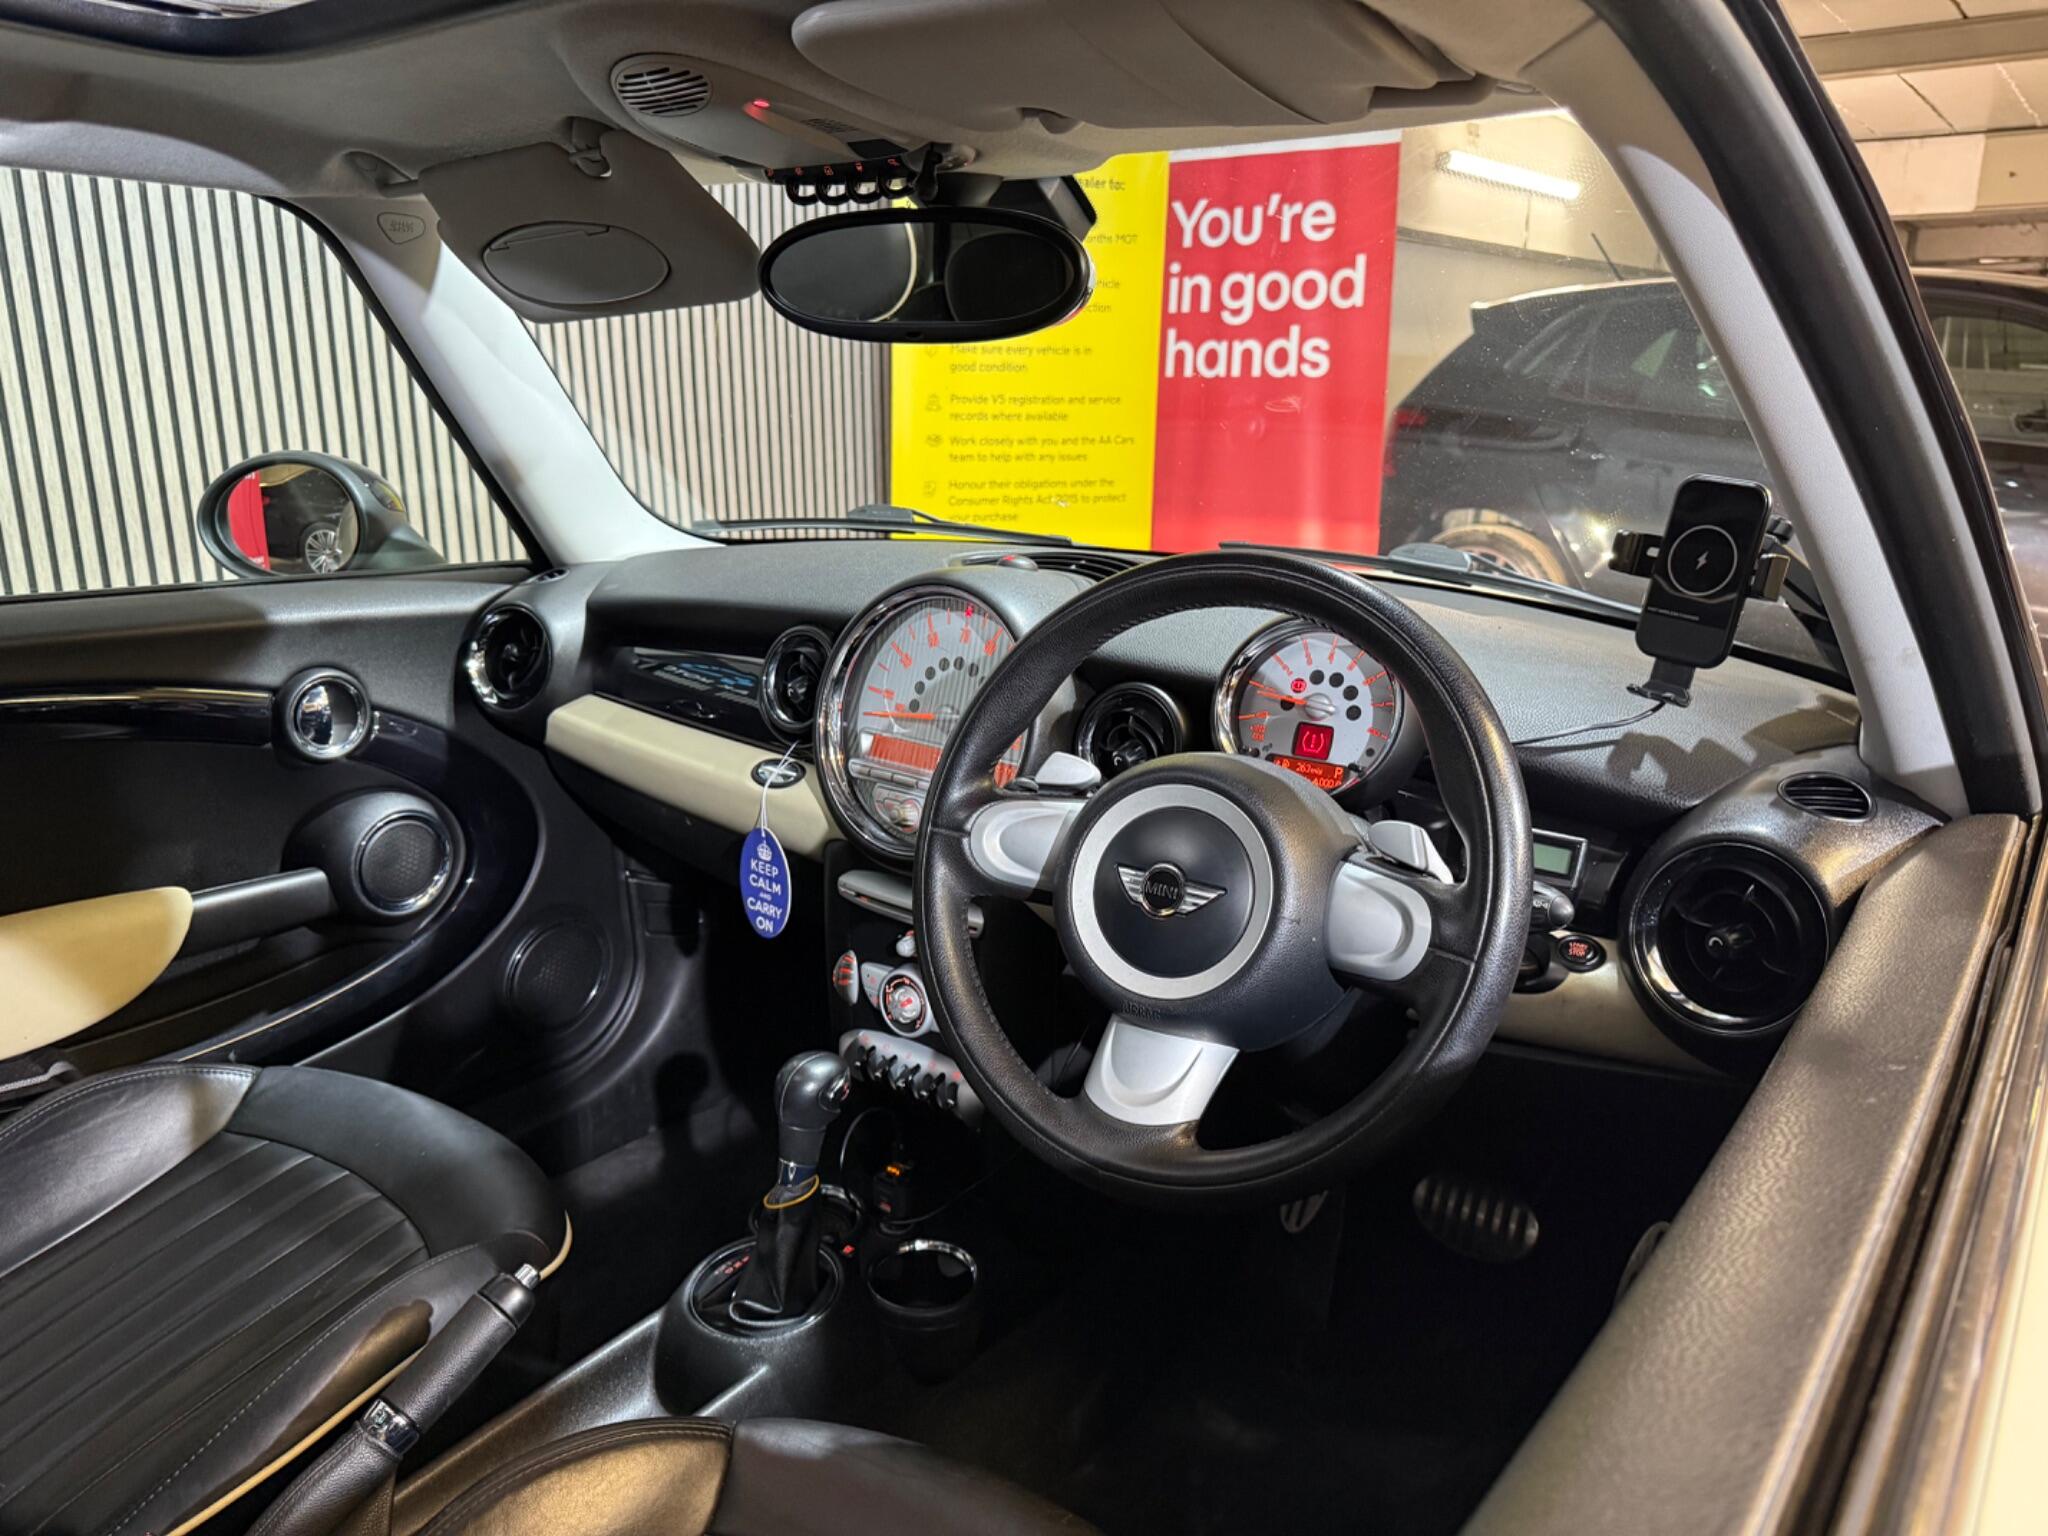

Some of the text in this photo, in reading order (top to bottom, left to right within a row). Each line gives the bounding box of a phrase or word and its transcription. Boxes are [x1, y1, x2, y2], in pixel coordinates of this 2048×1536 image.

[1167, 253, 1367, 326] in good
[981, 346, 1003, 355] sure
[1006, 346, 1033, 358] every
[1036, 344, 1071, 356] vehicle
[1164, 324, 1331, 379] hands
[949, 360, 1028, 374] good condition
[950, 393, 1121, 407] Provide V5 registration and service
[949, 411, 1069, 422] records where available
[949, 435, 976, 447] Work
[979, 435, 1014, 448] closely
[1017, 435, 1038, 446] with
[1041, 437, 1058, 449] you
[1060, 435, 1079, 446] and
[1081, 434, 1096, 445] the
[1113, 434, 1135, 446] Cars
[949, 452, 1088, 465] team to help with any issues
[949, 478, 1115, 491] Honour their obligations under the
[949, 496, 999, 506] Consumer
[1002, 495, 1033, 508] Rights
[1036, 494, 1052, 505] Act
[1081, 494, 1091, 504] to
[1092, 493, 1127, 506] protect
[750, 858, 779, 878] KEEP
[749, 874, 782, 896] CALM
[1145, 881, 1179, 900] MINI
[747, 896, 783, 919] CARRY
[755, 915, 774, 933] ON
